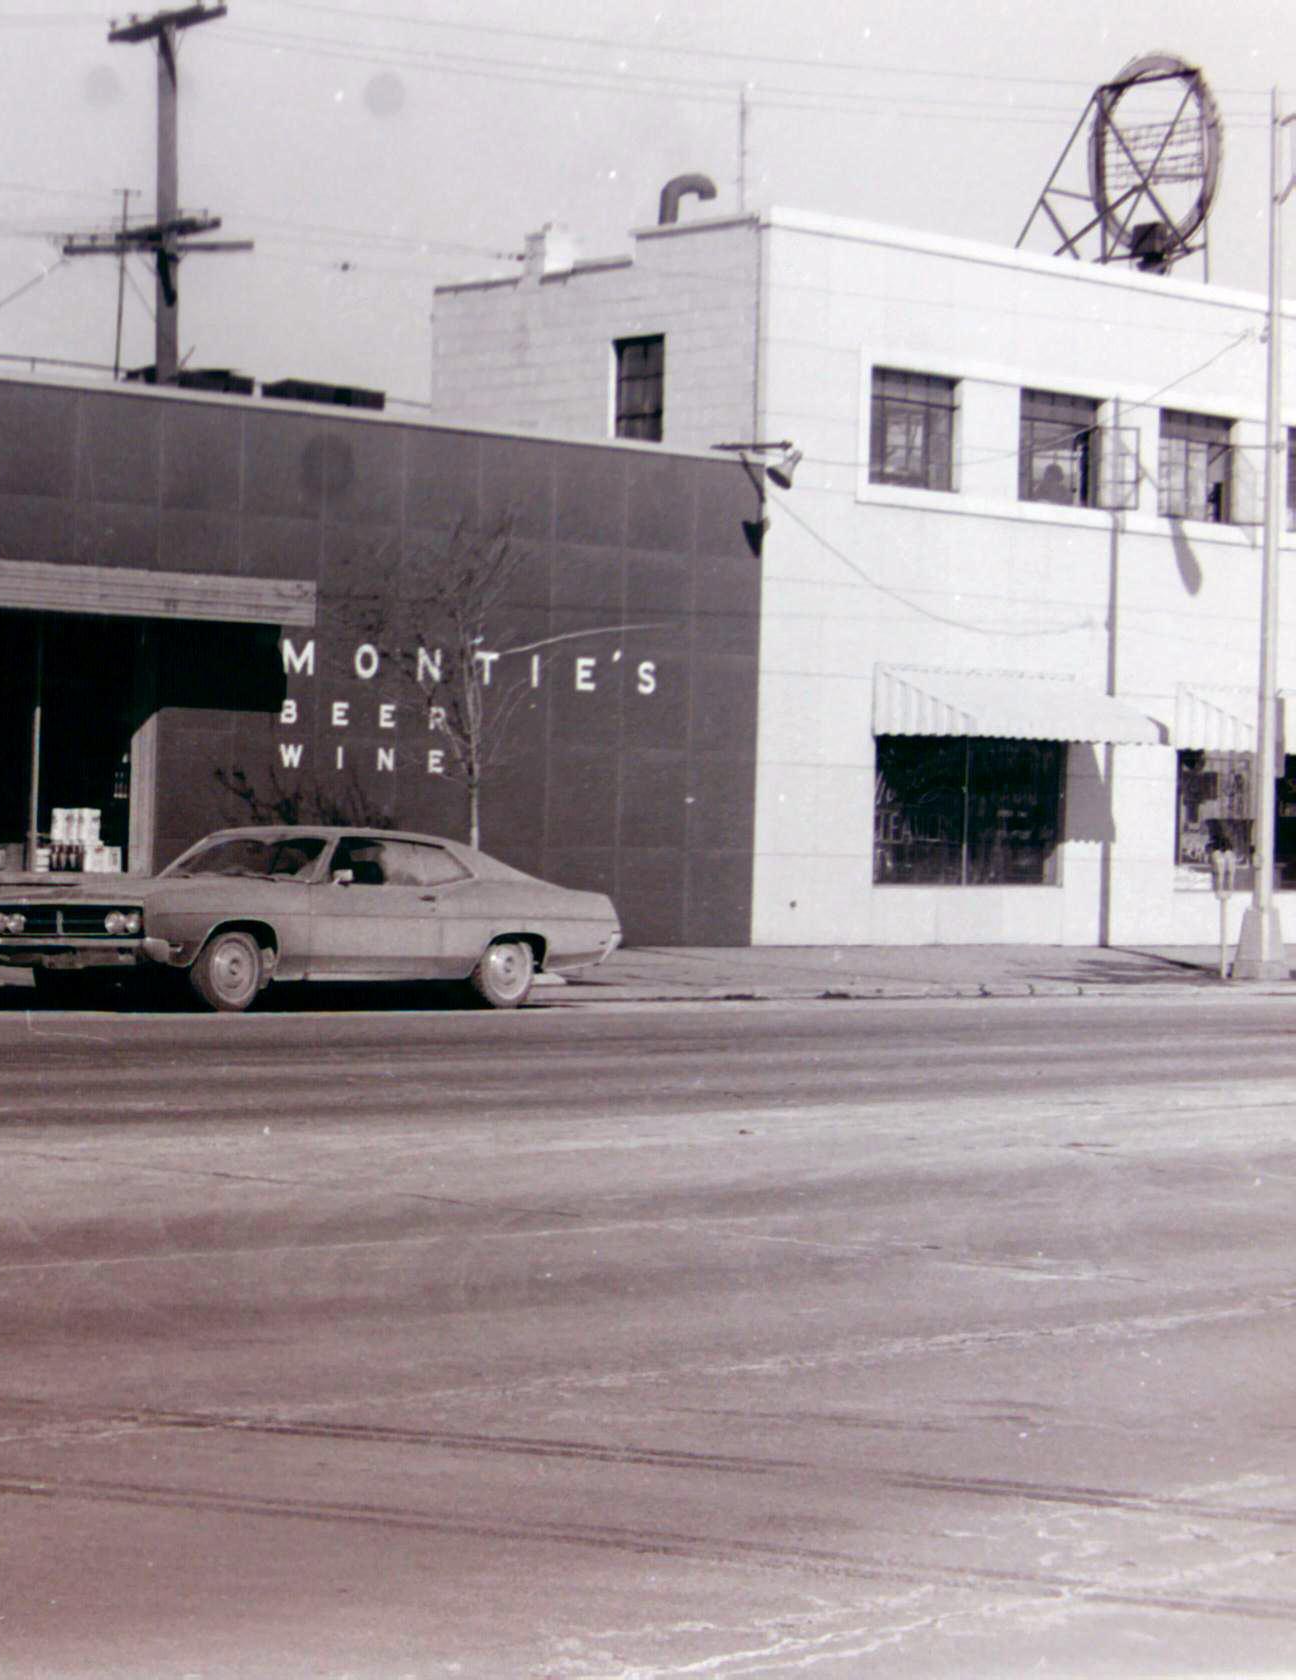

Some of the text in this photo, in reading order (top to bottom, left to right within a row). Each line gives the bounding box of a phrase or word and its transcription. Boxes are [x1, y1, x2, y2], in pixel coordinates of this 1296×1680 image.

[281, 639, 657, 695] MONTIE'S
[279, 698, 447, 731] BEER
[278, 743, 445, 774] WINE
